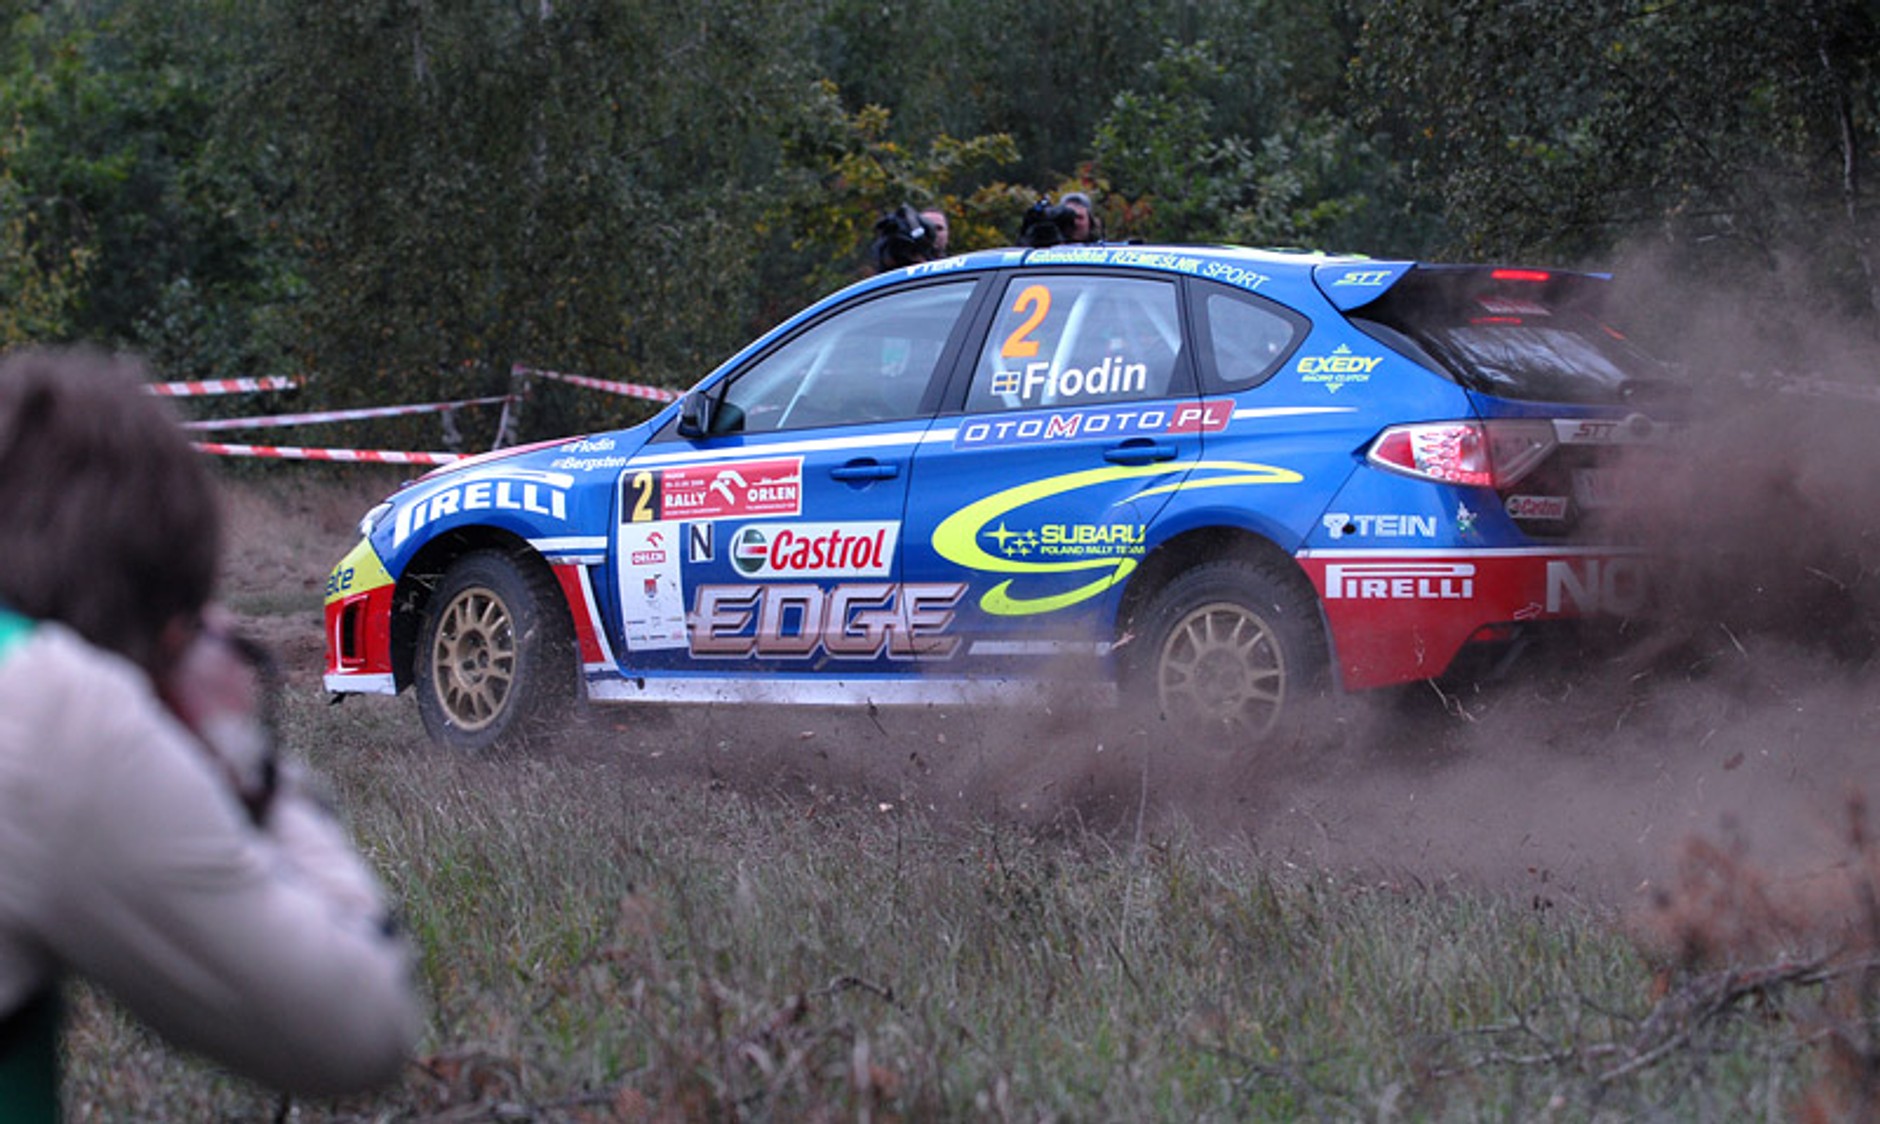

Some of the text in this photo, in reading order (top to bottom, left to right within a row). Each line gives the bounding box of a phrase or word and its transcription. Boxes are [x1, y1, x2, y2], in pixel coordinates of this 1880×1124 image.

[1203, 260, 1271, 290] SPORT
[1000, 284, 1052, 358] 2
[1021, 357, 1147, 399] Flodin
[1297, 355, 1384, 373] EXEDY
[963, 406, 1222, 441] OTOMOTO.PL
[571, 437, 616, 452] Flodin
[562, 456, 626, 471] Bergsten
[393, 470, 574, 549] PIRELLI
[631, 471, 654, 522] 2
[664, 491, 707, 508] RALLY
[747, 486, 796, 502] ORLEN
[1041, 524, 1146, 543] SUBARU
[1353, 514, 1437, 537] TEIN
[690, 524, 712, 561] N
[770, 528, 887, 571] Castrol
[1041, 545, 1146, 556] POLAND RALLY TEAM
[1325, 563, 1476, 599] PIRELLI
[687, 583, 969, 661] EDGE
